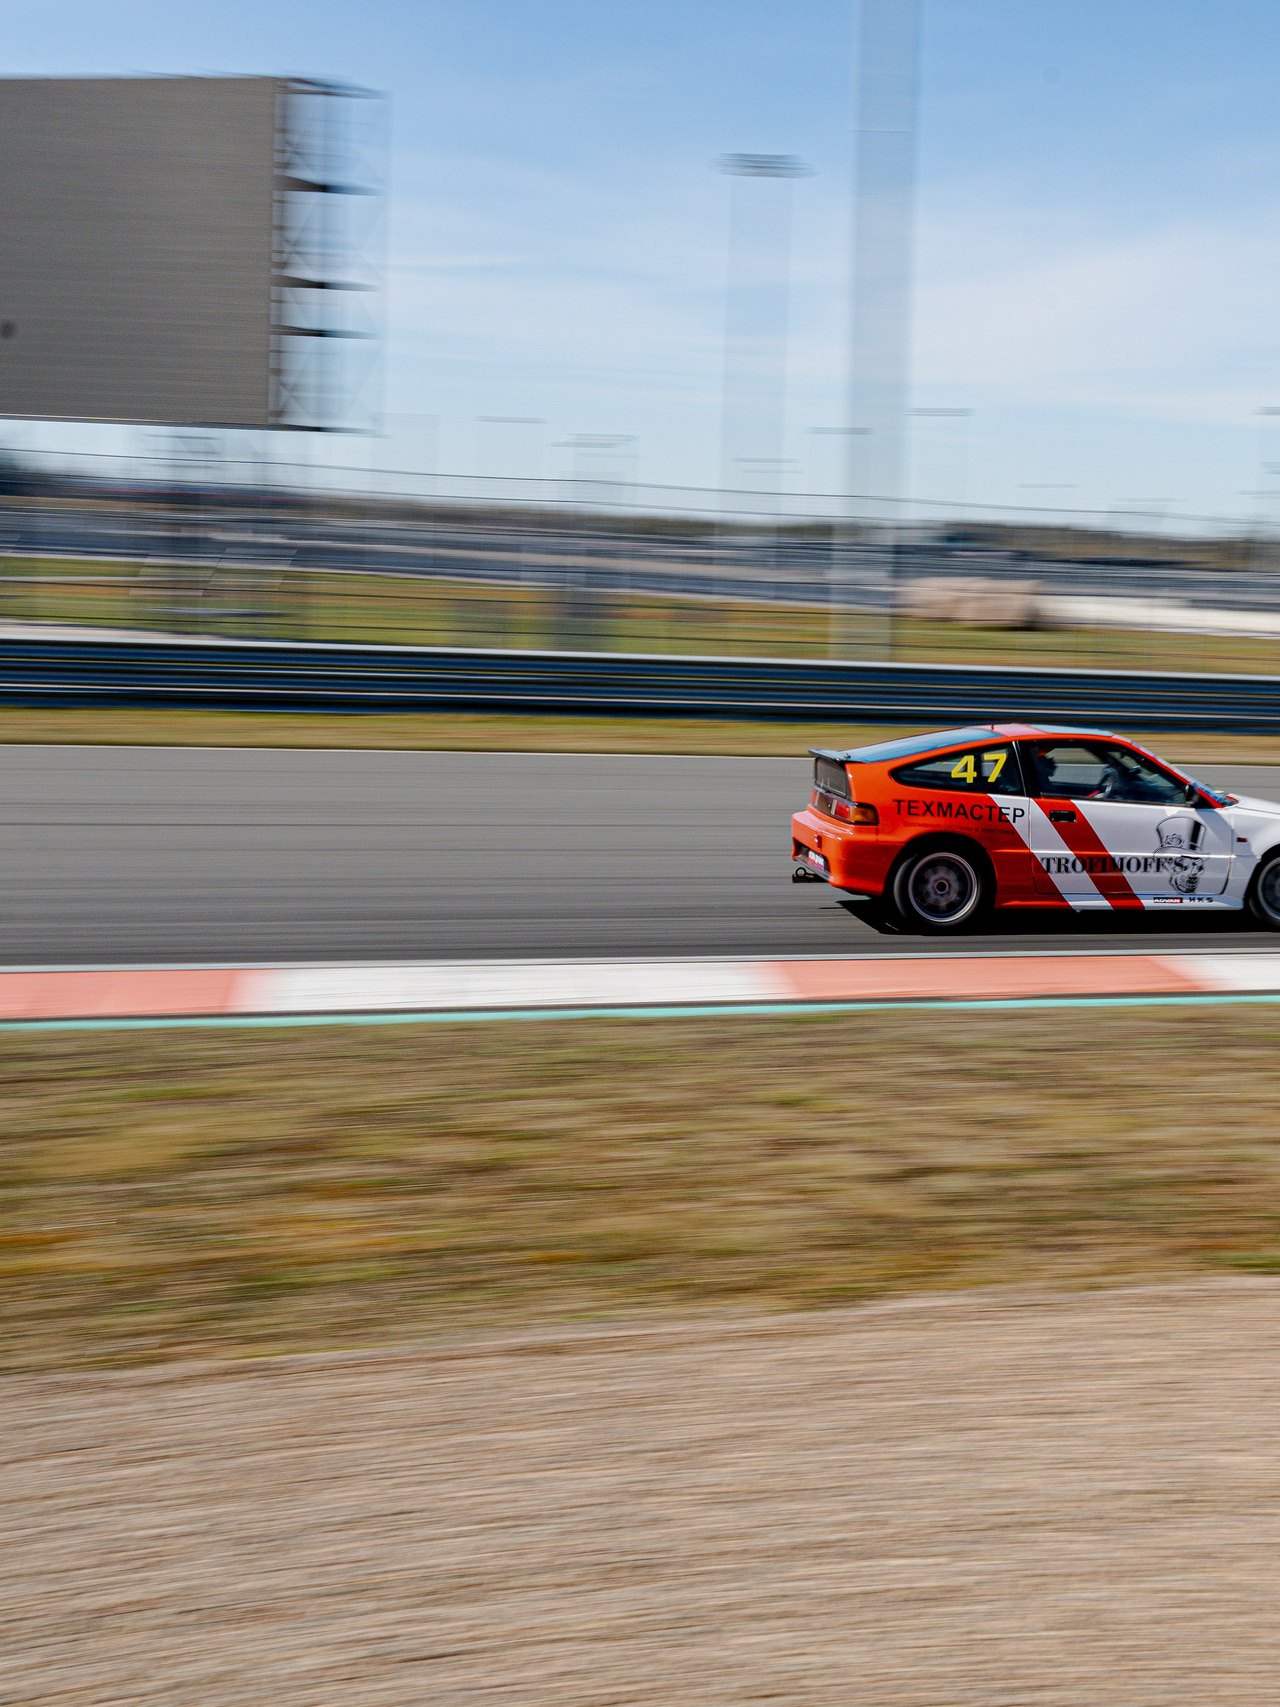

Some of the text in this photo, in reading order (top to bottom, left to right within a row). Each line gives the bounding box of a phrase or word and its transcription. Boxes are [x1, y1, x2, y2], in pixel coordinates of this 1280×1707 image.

[951, 753, 1007, 783] 47
[892, 799, 1025, 823] ТЕХМАСТЕР
[1041, 857, 1185, 874] TROFIMOFF'S
